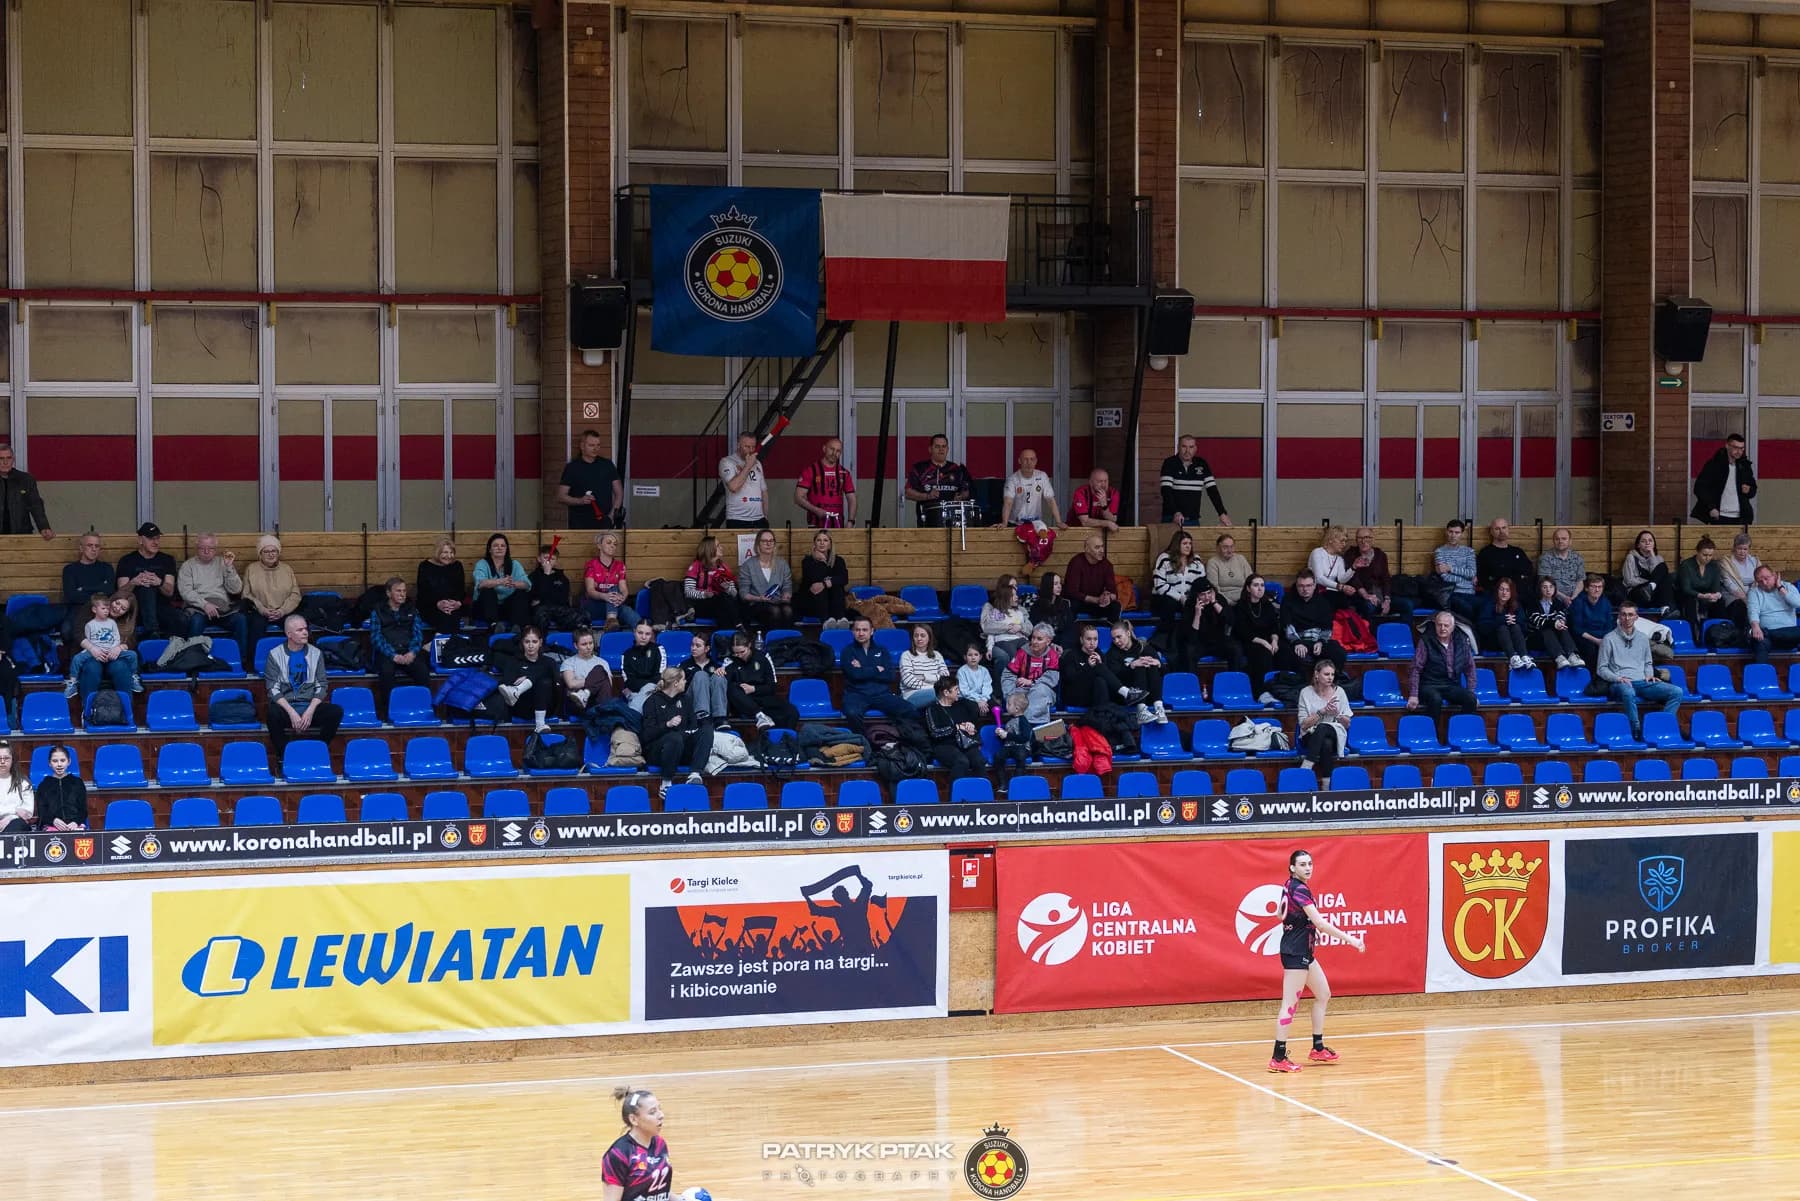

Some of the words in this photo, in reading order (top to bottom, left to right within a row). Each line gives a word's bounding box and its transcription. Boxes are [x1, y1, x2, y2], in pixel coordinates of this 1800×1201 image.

[715, 234, 752, 247] SUZUKI
[694, 280, 728, 313] KORONA
[730, 282, 774, 314] HANDBALL
[1603, 420, 1613, 430] C
[1260, 790, 1476, 815] www.koronahandball.pl
[1578, 782, 1781, 804] www.koronahandball.pl
[557, 813, 803, 839] www.koronahandball.pl
[920, 803, 1151, 827] www.koronahandball.pl
[170, 825, 432, 853] www.koronahandball.pl
[687, 877, 709, 888] Targi
[711, 876, 739, 885] Kielce
[1092, 901, 1133, 917] LIGA
[1317, 892, 1347, 908] IGA
[1092, 918, 1196, 937] CENTRALNA
[1318, 909, 1407, 927] ENTRALNA
[1606, 915, 1716, 940] PROFIKA
[1454, 897, 1528, 962] CK
[271, 922, 604, 990] LEWIATAN
[1092, 939, 1155, 956] KOBIET
[1623, 941, 1699, 954] BROKER
[671, 961, 734, 977] Zawsze
[738, 959, 768, 977] jest
[773, 959, 810, 975] pora
[814, 958, 834, 970] na
[838, 954, 889, 971] targi...
[671, 985, 675, 998] i
[680, 980, 777, 998] kibicowanie
[648, 1166, 669, 1192] 22
